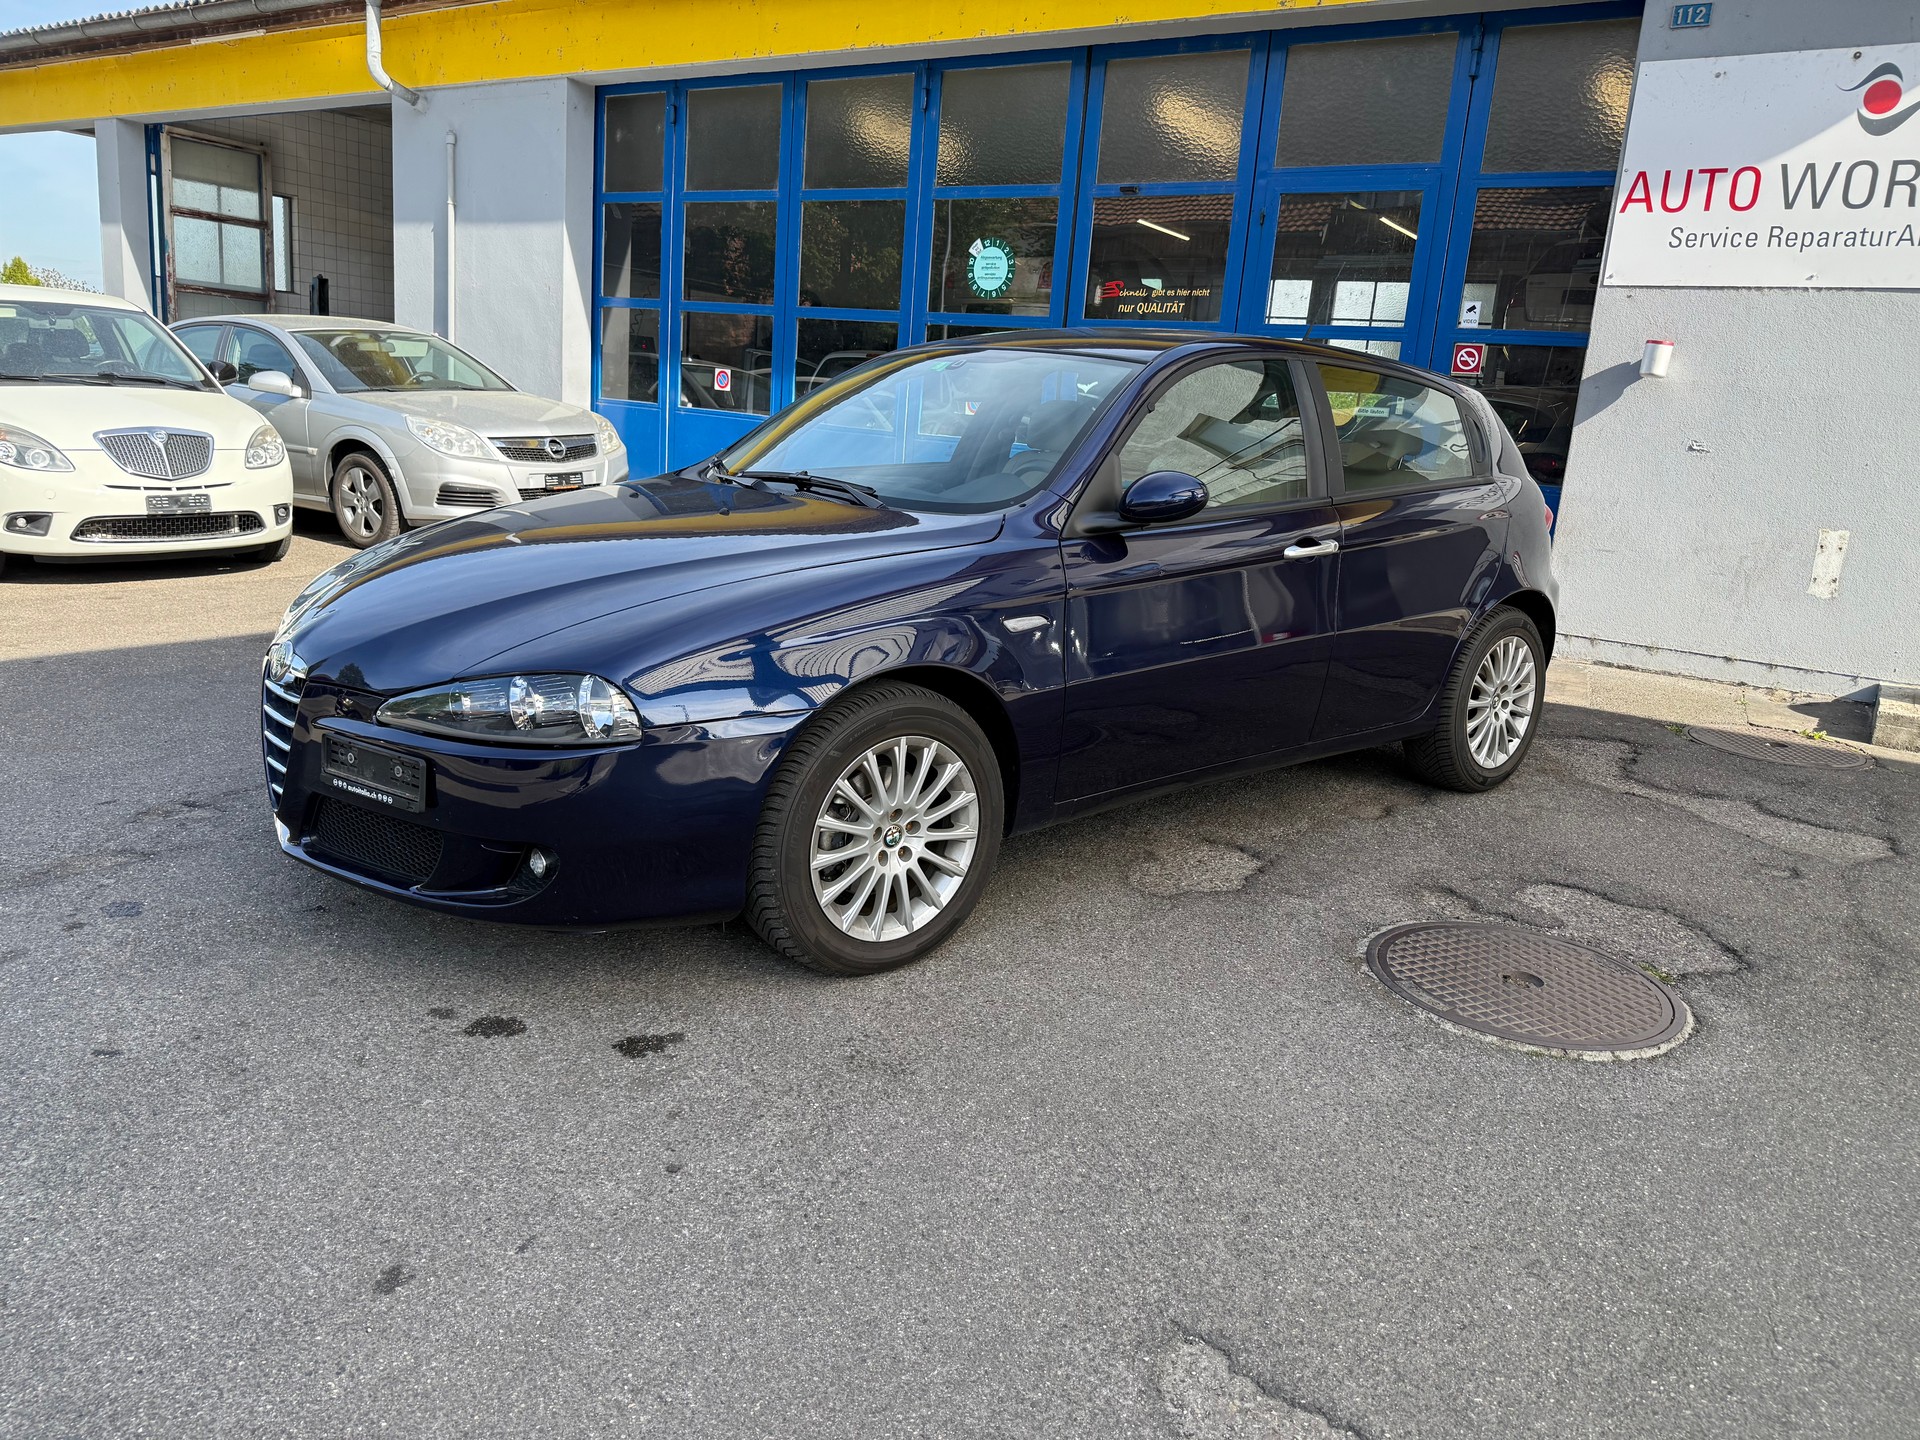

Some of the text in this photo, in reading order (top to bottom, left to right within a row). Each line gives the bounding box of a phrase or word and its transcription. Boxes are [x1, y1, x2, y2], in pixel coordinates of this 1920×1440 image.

[1677, 6, 1706, 24] 112
[1619, 159, 1920, 214] AUTO WOR
[984, 239, 991, 247] 12
[1668, 224, 1920, 253] Service ReparaturA
[968, 257, 975, 266] 10
[1099, 280, 1149, 298] Schnell
[1151, 289, 1165, 298] gibt
[1176, 288, 1191, 296] hier
[1191, 288, 1210, 296] nicht
[1118, 300, 1185, 314] nur QUALITÄT
